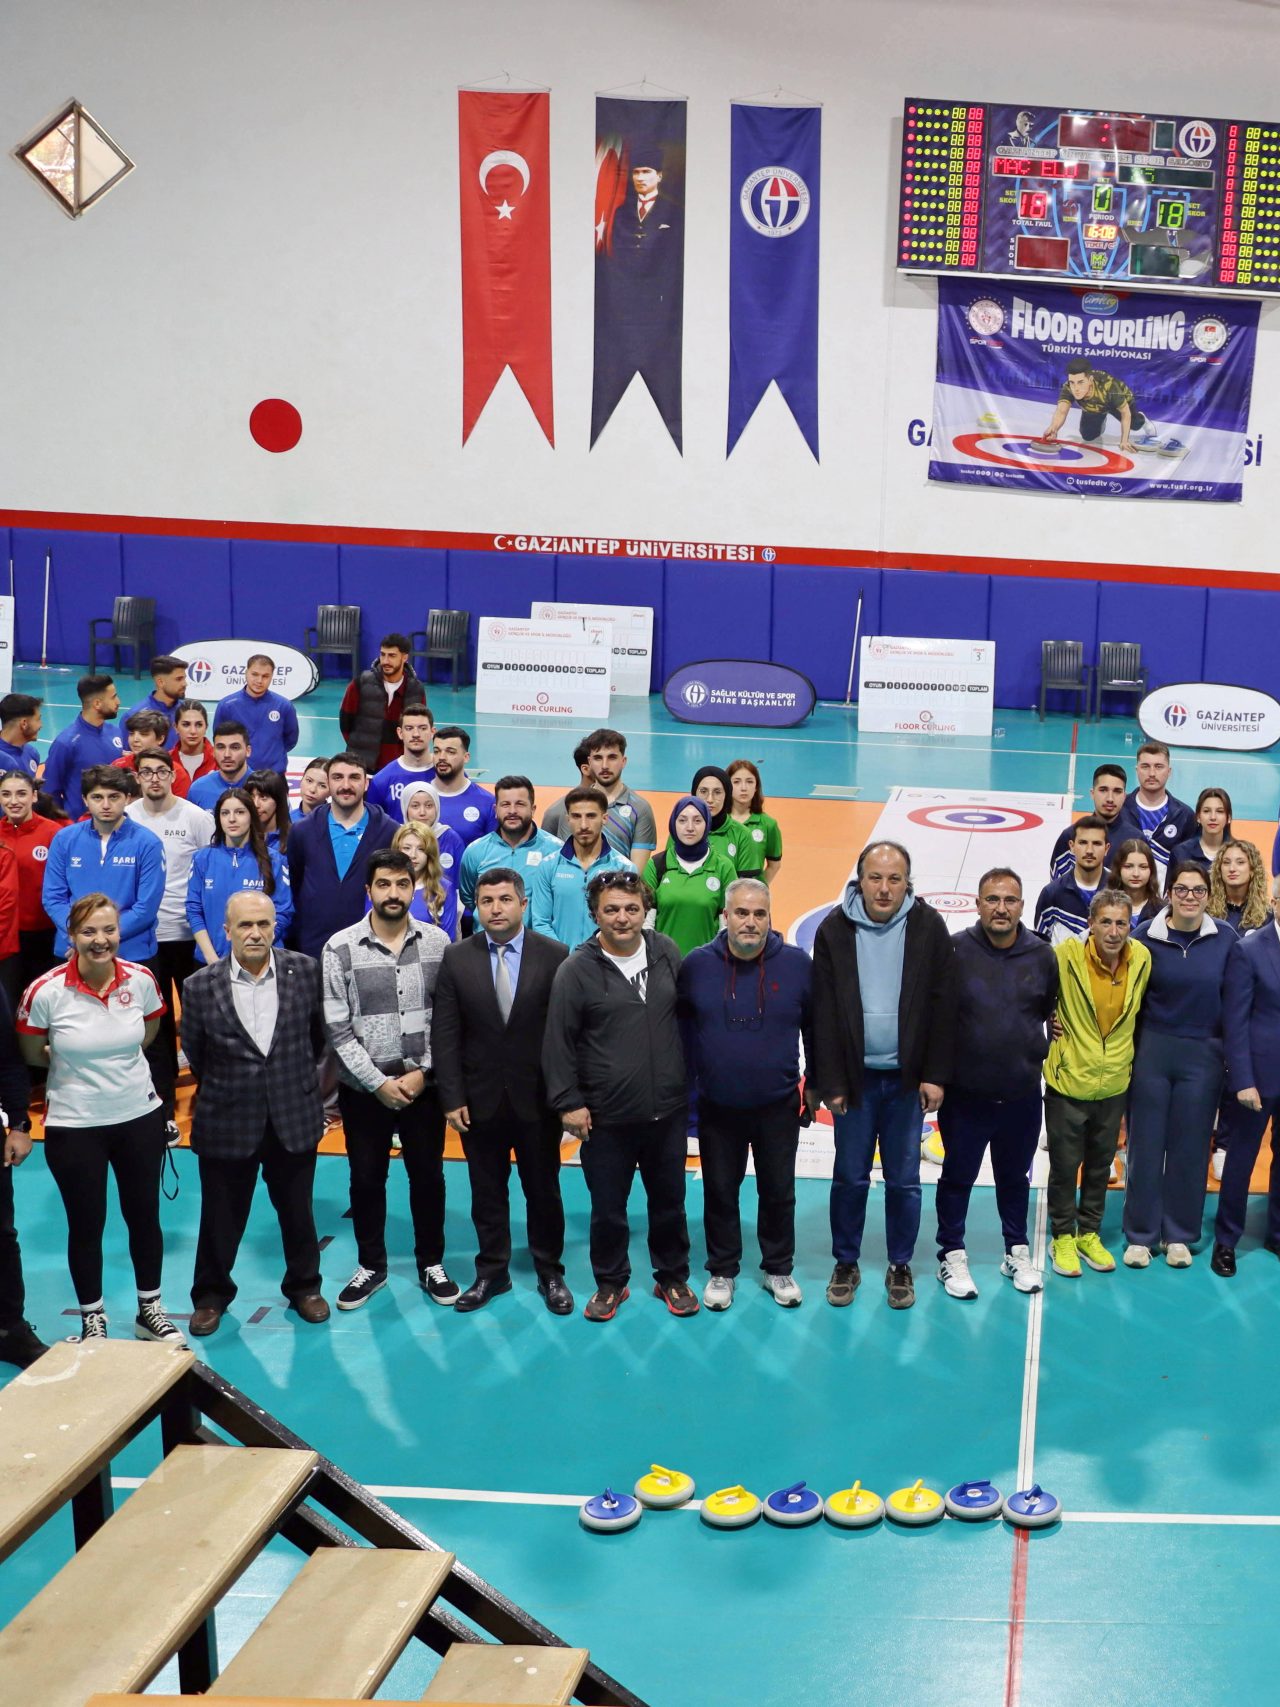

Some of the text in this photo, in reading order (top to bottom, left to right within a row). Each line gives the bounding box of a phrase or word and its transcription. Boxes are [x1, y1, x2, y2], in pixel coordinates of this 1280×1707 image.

[1020, 193, 1046, 218] 18
[1159, 203, 1184, 228] 18
[1011, 296, 1082, 344] FLOOR
[1042, 343, 1152, 360] TÜRKİYE ŞAMPİYONASI
[711, 689, 736, 697] SAĞLIK
[738, 690, 764, 698] KÜLTÜR
[711, 696, 796, 707] DAİRE BAŞKANLIĞI
[1196, 710, 1266, 722] GAZİANTEP
[1202, 722, 1259, 732] ÜNİVERSİTESİ
